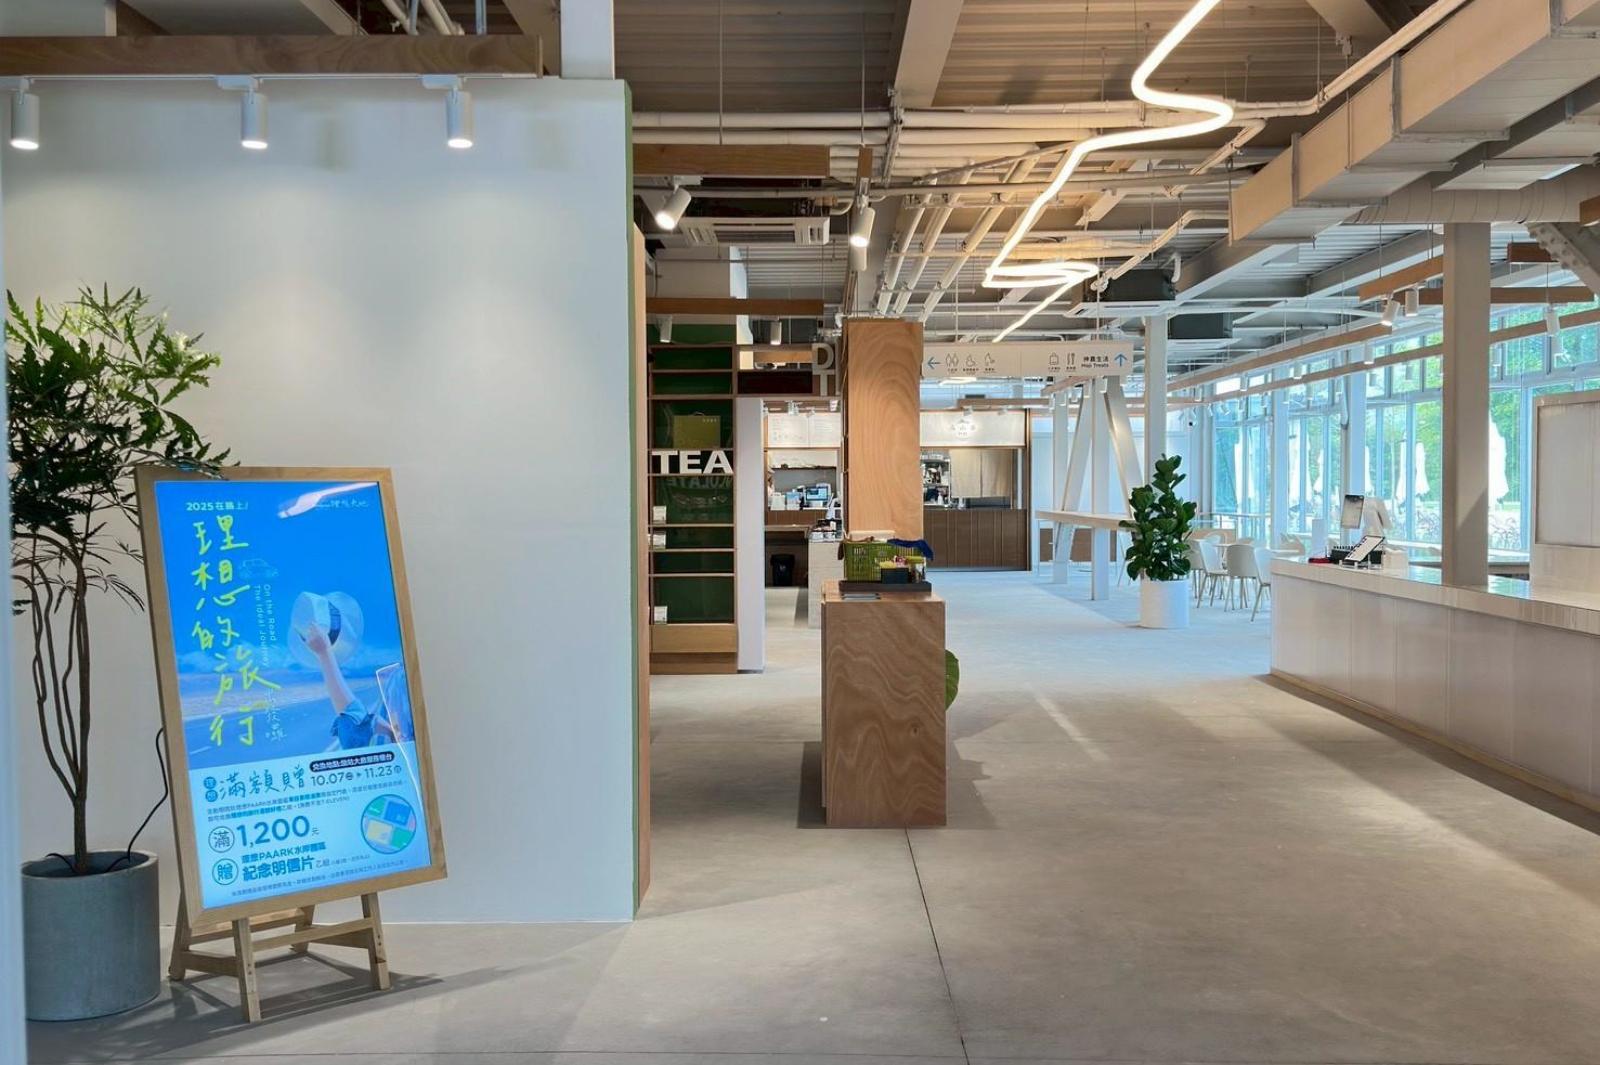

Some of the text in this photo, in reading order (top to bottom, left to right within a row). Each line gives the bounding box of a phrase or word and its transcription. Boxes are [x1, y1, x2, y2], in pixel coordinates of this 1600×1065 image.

[651, 450, 734, 474] TEA
[268, 618, 277, 641] Road
[236, 815, 310, 848] 1,200
